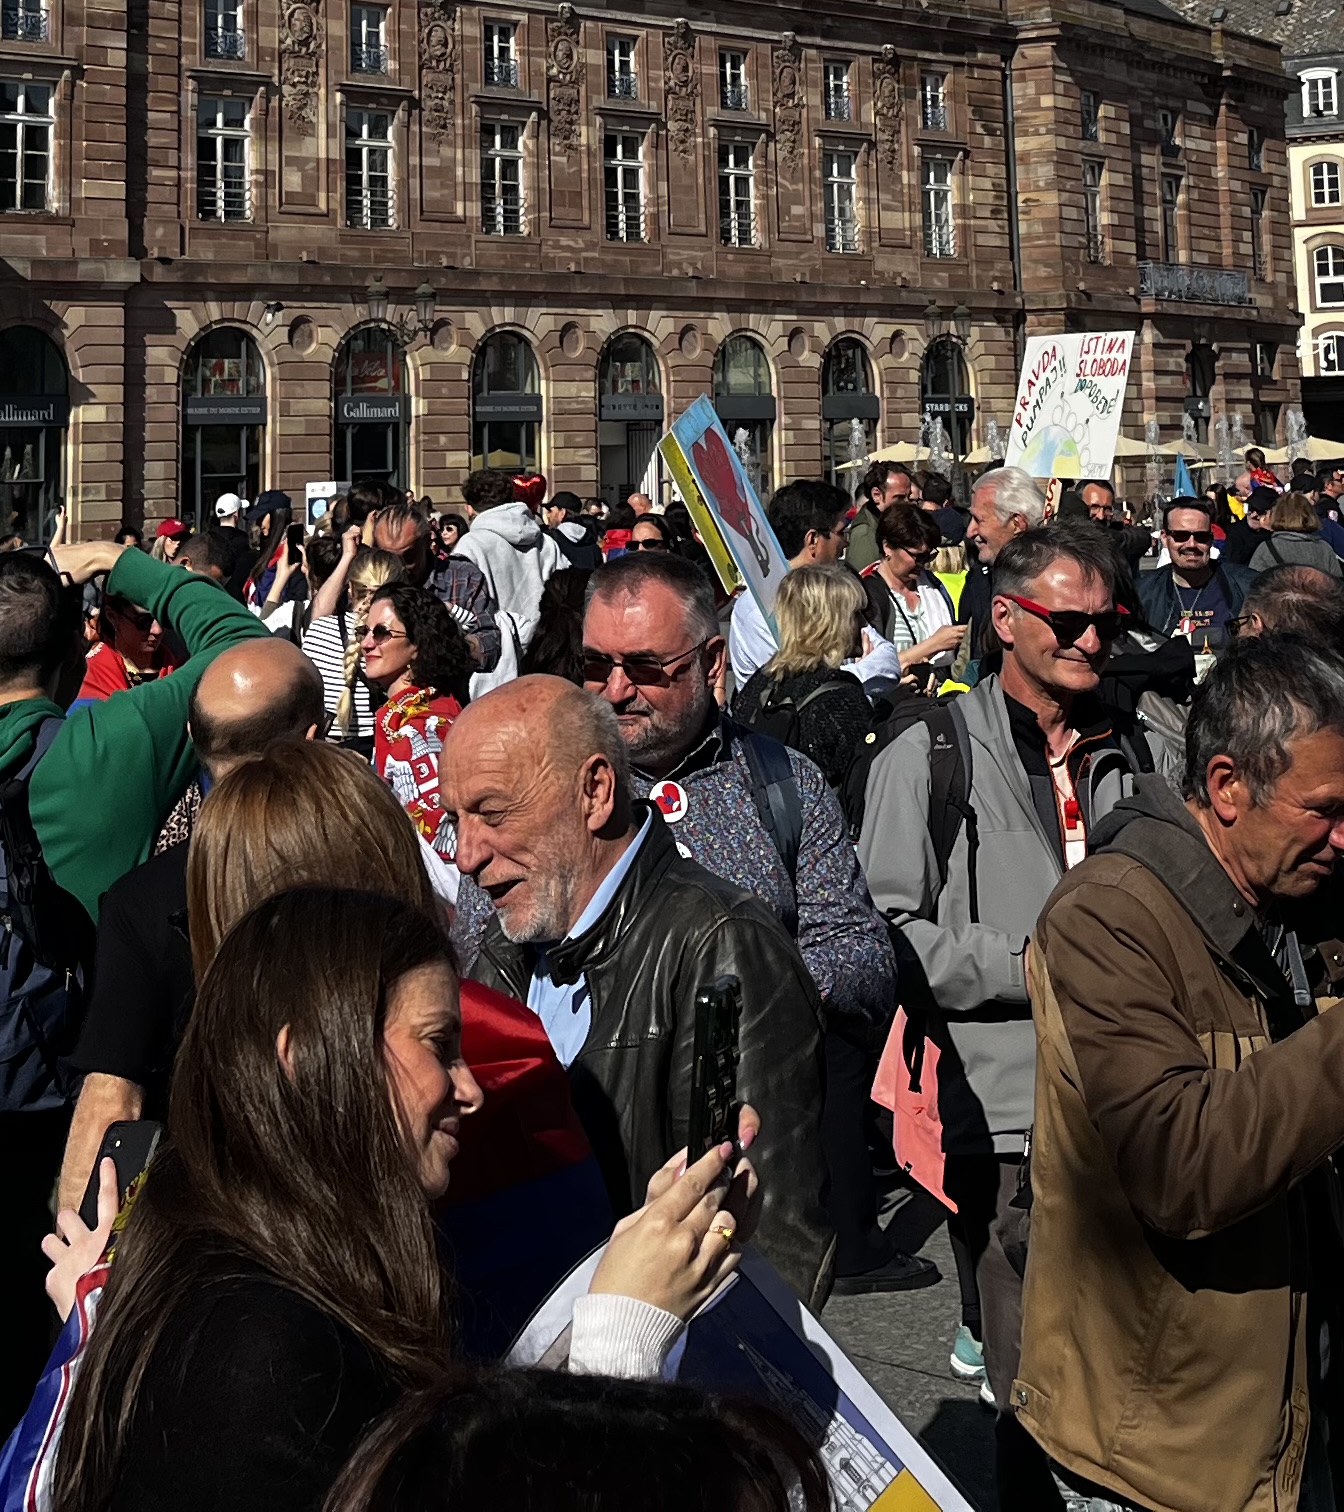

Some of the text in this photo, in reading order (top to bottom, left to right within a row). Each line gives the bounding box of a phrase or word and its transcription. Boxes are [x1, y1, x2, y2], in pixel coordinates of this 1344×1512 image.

[1076, 357, 1127, 377] SLOBODA
[1014, 345, 1057, 428] PRAVDA
[343, 402, 400, 418] Gallimard
[925, 403, 968, 411] STARBCKS
